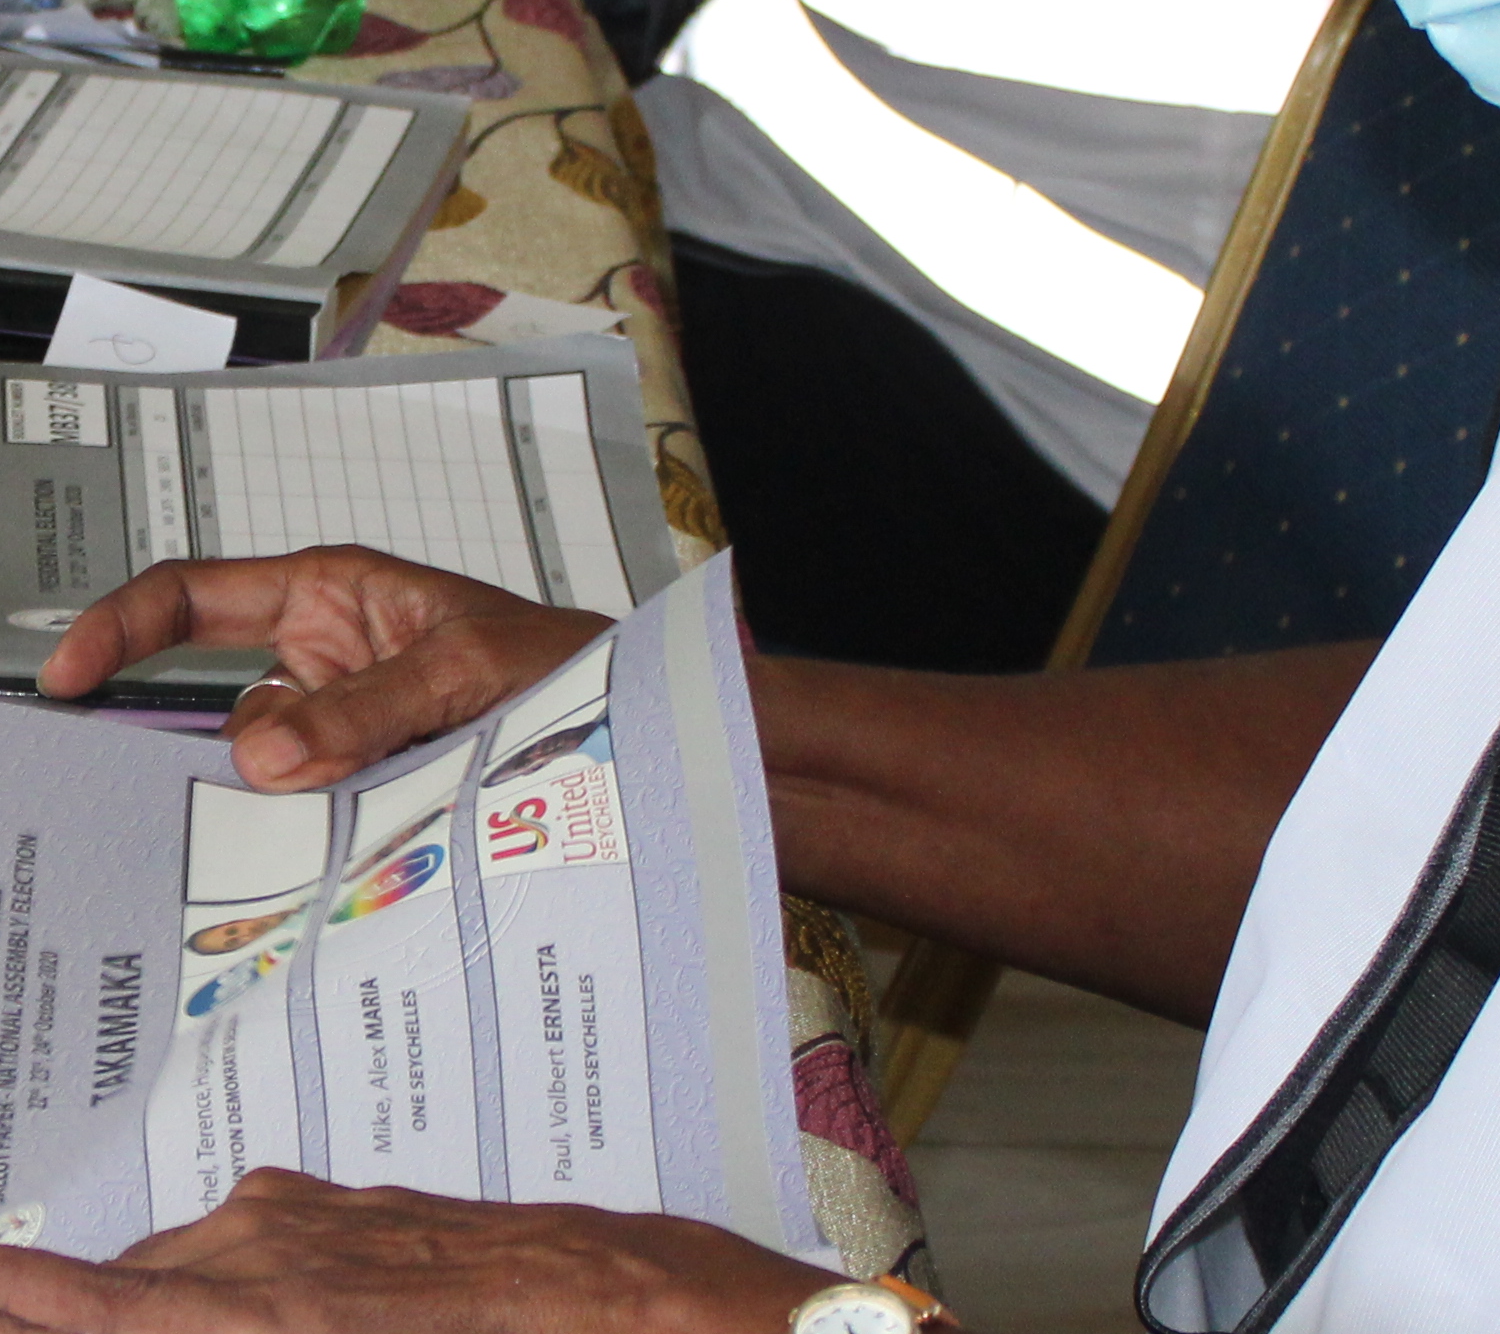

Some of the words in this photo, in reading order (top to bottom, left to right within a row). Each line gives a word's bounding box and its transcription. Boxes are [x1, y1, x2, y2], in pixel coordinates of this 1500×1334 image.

[33, 479, 56, 529] ELECTION
[64, 484, 82, 505] 2020
[66, 507, 85, 540] October
[37, 531, 60, 593] PRESIDENTIAL
[552, 772, 598, 863] United
[586, 765, 618, 862] SEYCHELLES
[10, 832, 38, 914] ELECTION
[6, 918, 30, 1003] ASSEMBLY
[36, 951, 58, 981] 2020
[535, 943, 563, 1042] ERNESTA
[31, 982, 57, 1032] October
[89, 952, 143, 1107] TAKAMAKA
[359, 976, 384, 1040] MARIA
[577, 974, 600, 1080] SEYCHELLES
[370, 1045, 389, 1090] Alex
[400, 989, 424, 1091] SEYCHELLES
[409, 1094, 428, 1131] ONE
[543, 1048, 569, 1128] Volbert
[583, 1083, 604, 1150] UNITED
[194, 1087, 217, 1160] Terence,
[371, 1094, 395, 1153] Mike,
[550, 1131, 576, 1182] Paul,
